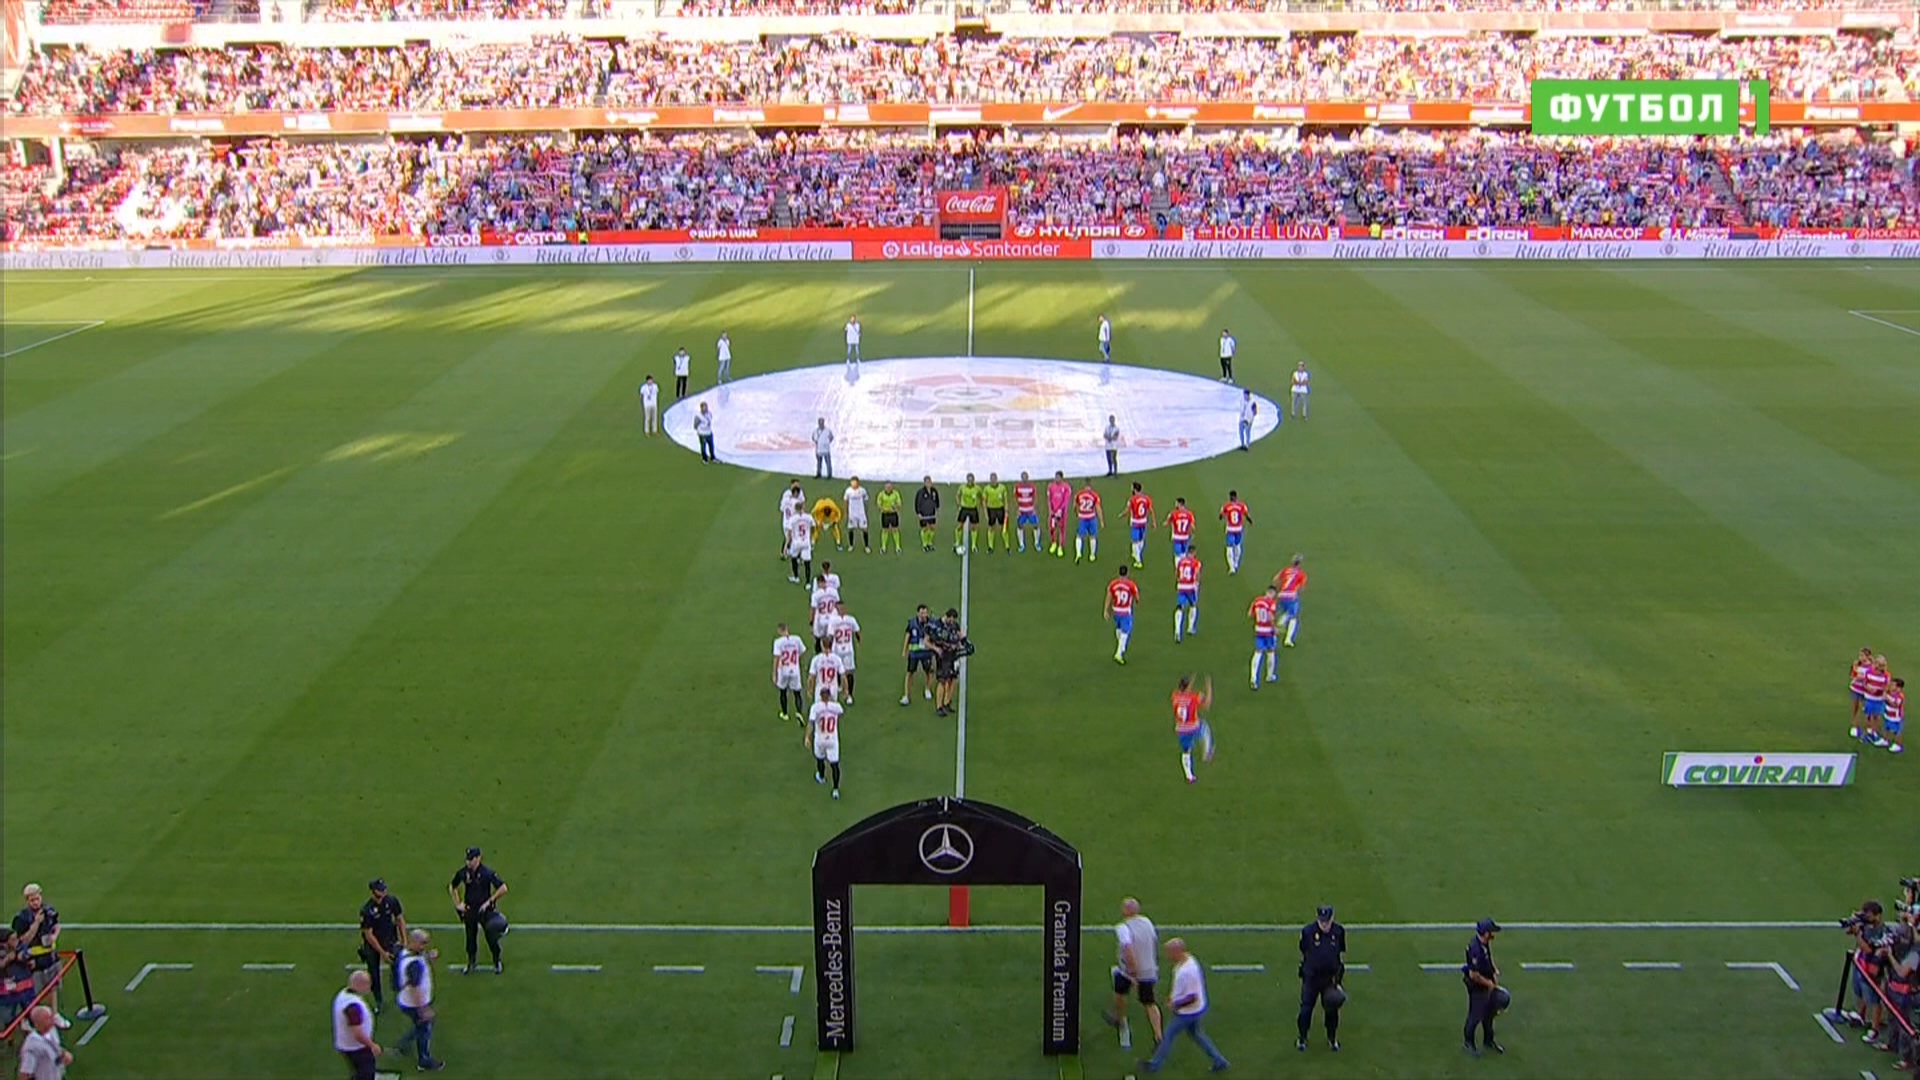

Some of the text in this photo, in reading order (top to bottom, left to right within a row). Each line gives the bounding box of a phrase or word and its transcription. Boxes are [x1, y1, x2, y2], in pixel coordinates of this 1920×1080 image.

[730, 229, 758, 238] LUNA
[1039, 226, 1120, 237] HYUNDAI
[1215, 226, 1324, 239] HOTEL LUNA
[1571, 227, 1643, 239] MARACOF
[430, 234, 481, 246] CASTOR
[536, 246, 650, 262] Ruta del Veleta
[717, 244, 833, 260] Ruta del Veleta
[903, 241, 1060, 257] LaLiga Santander
[1148, 242, 1263, 257] Ruta del Veleta
[1333, 242, 1449, 257] Ruta del Veleta
[1515, 242, 1632, 257] Ruta del Veleta
[1704, 242, 1822, 257] Ruta del Veleta
[1890, 243, 1920, 257] Rut
[60, 252, 104, 268] Veleta
[1080, 499, 1093, 512] 22
[1138, 502, 1146, 516] 6
[1230, 510, 1239, 524] 8
[799, 524, 806, 538] 5
[1175, 518, 1190, 532] 17
[1179, 566, 1192, 580] 14
[1114, 590, 1129, 605] 19
[835, 629, 851, 644] 25
[781, 650, 798, 666] 24
[819, 668, 836, 683] 19
[819, 716, 836, 733] 10
[1053, 900, 1071, 1042] Granada Premium
